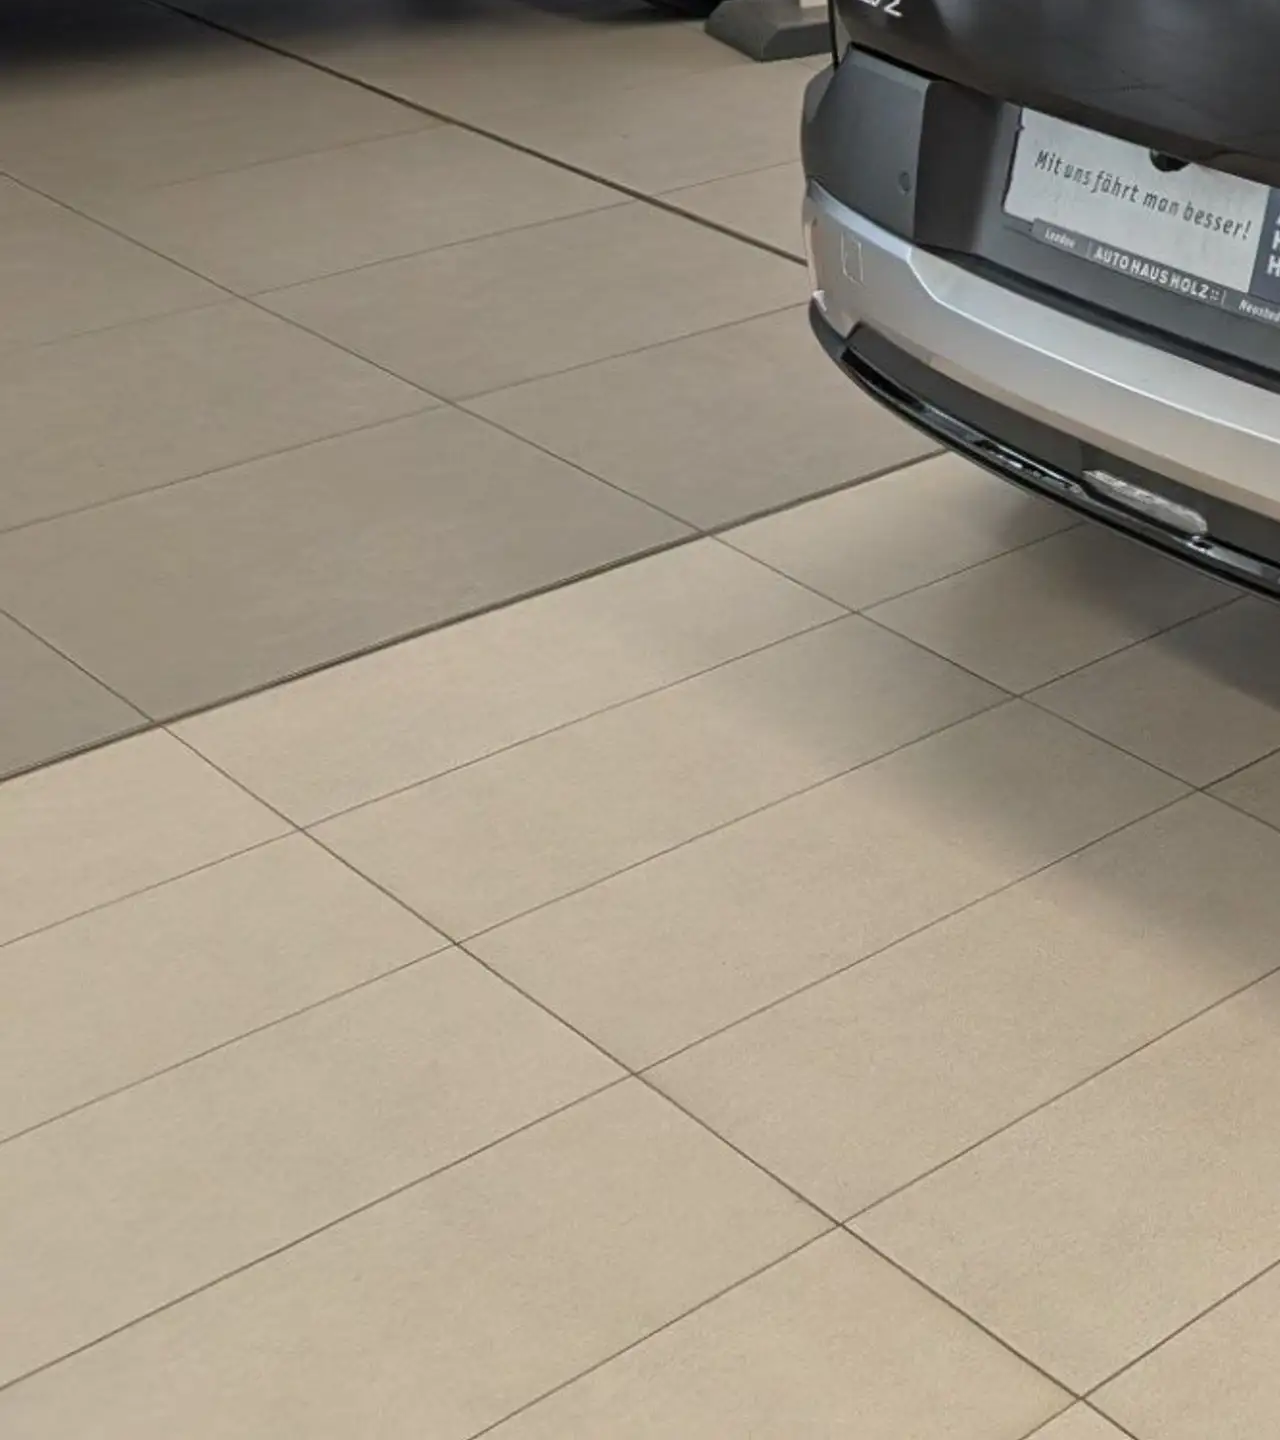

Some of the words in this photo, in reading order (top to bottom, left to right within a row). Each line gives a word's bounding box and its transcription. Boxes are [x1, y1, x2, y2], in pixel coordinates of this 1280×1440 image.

[1034, 149, 1062, 174] Mit
[1064, 164, 1091, 186] uns
[1091, 170, 1140, 204] fährt
[1143, 191, 1180, 216] man
[1183, 202, 1252, 241] besser!
[1170, 274, 1210, 302] HOLZ
